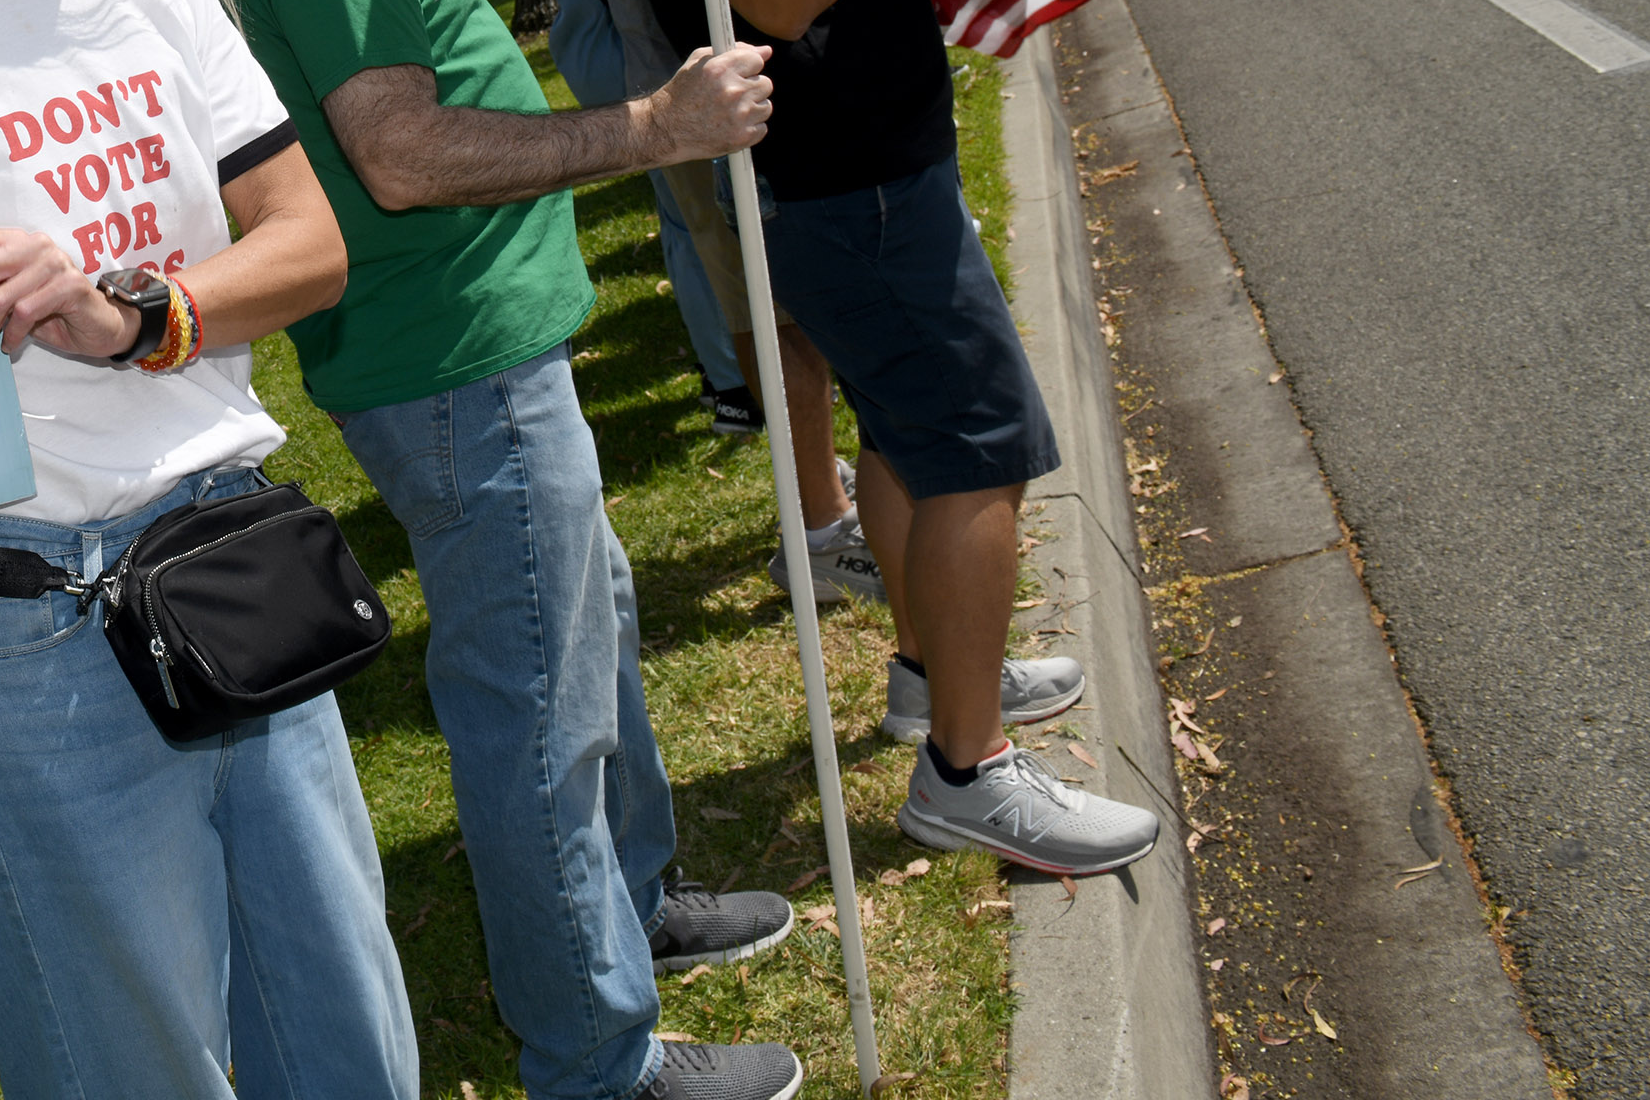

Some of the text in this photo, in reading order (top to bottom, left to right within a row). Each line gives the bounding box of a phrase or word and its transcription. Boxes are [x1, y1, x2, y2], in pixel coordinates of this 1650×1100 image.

[34, 133, 171, 215] VOTE
[72, 201, 162, 275] FOR
[716, 402, 750, 421] HOKA
[835, 555, 880, 577] HOK
